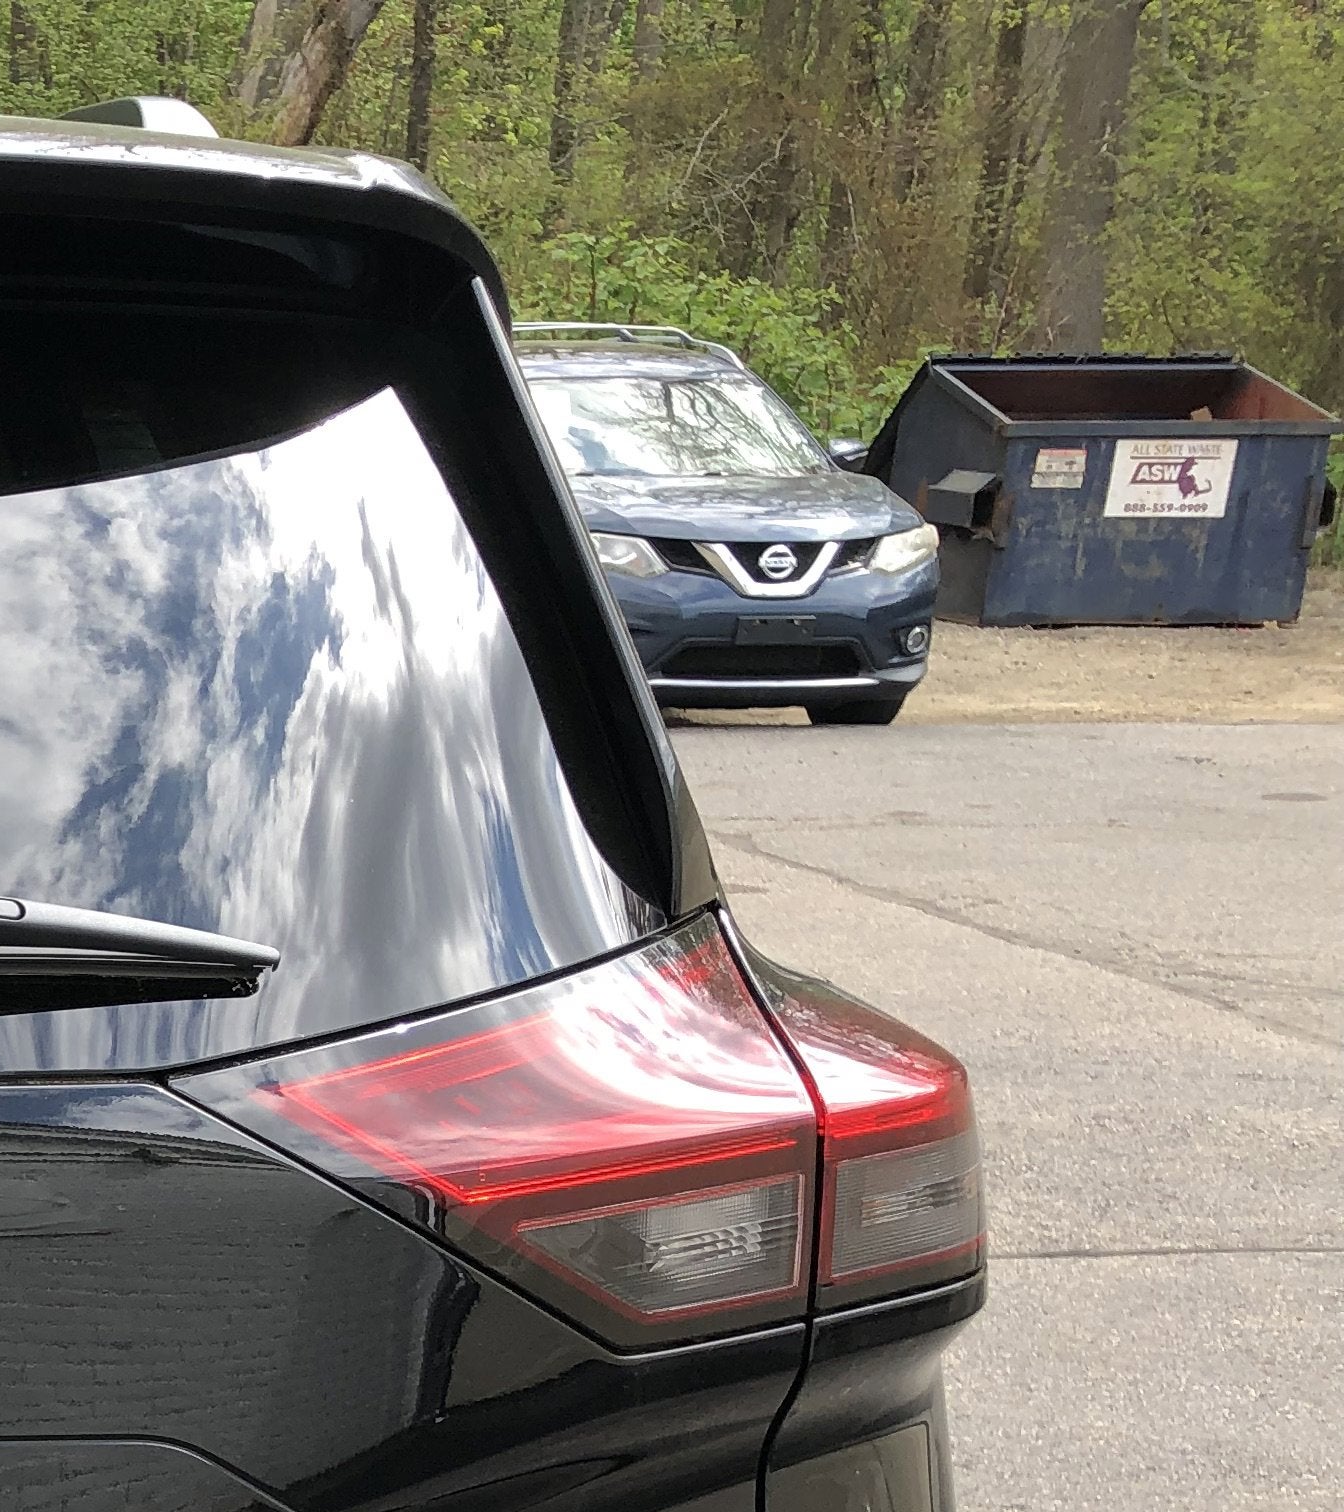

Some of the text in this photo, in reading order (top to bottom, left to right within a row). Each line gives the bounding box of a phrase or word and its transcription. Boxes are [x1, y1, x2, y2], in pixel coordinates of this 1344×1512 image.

[1131, 444, 1151, 455] ALL
[1154, 444, 1183, 456] STATE
[1136, 464, 1183, 481] ASW
